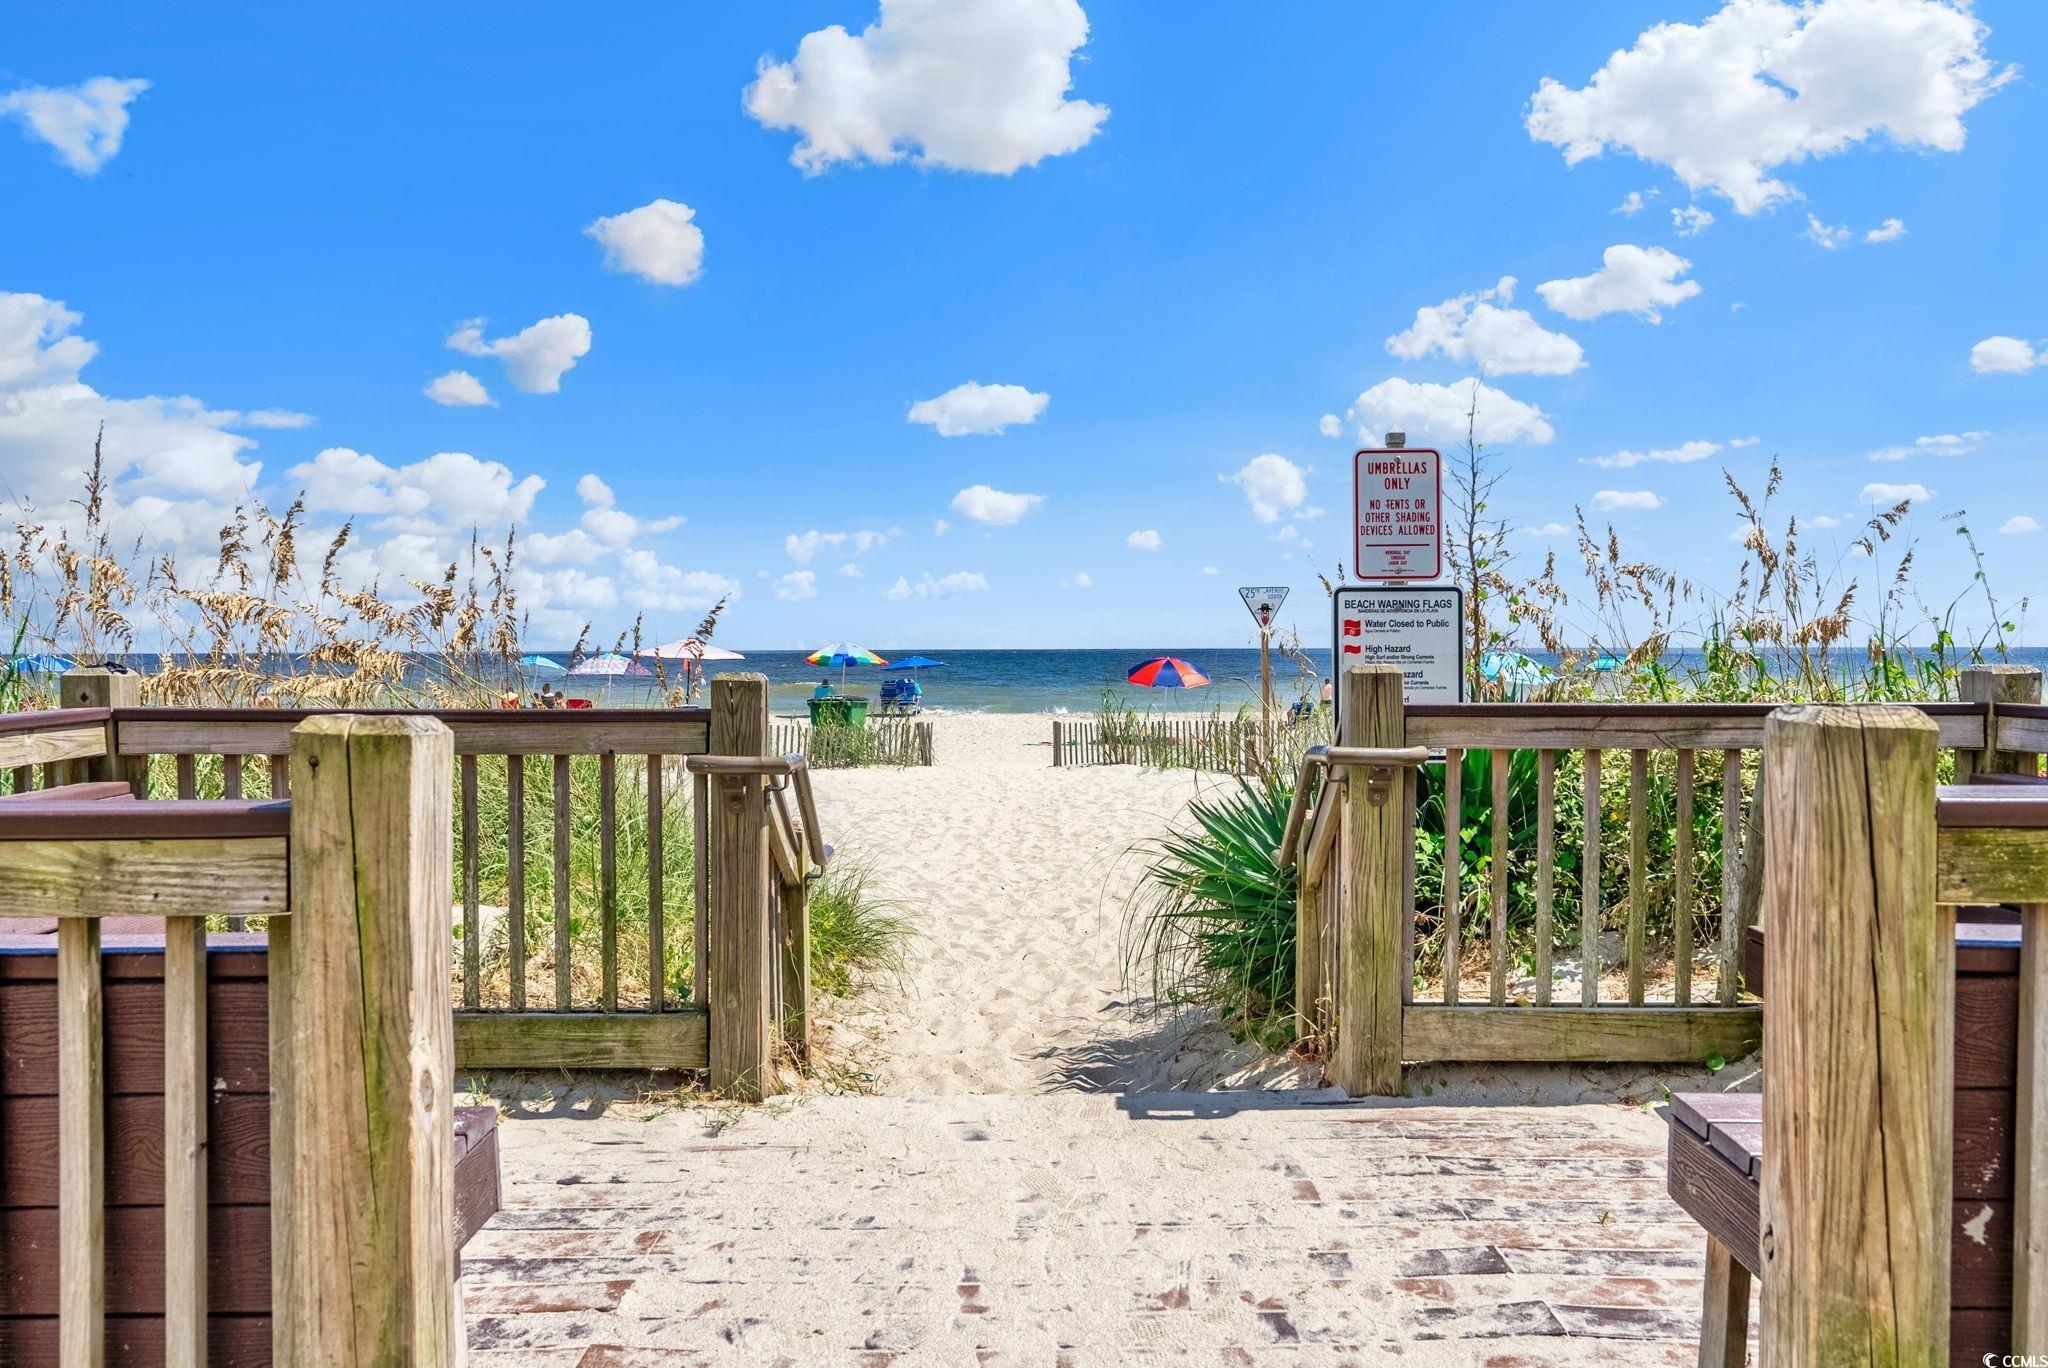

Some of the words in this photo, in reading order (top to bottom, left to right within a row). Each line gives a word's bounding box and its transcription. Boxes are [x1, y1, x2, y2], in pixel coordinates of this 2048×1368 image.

[1368, 462, 1427, 474] UMBRELLAS
[1384, 478, 1410, 490] ONLY
[1370, 500, 1380, 510] NO
[1386, 499, 1410, 509] TENTS
[1415, 499, 1425, 509] OR
[1365, 513, 1390, 522] OTHER
[1396, 512, 1430, 522] SHADING
[1361, 525, 1392, 536] DEVICES
[1398, 525, 1435, 535] ALLOWED
[1344, 600, 1375, 609] BEACH
[1378, 599, 1420, 608] WARNING
[1423, 600, 1452, 608] FLAGS
[1365, 645, 1382, 654] High
[1404, 670, 1423, 678] azard
